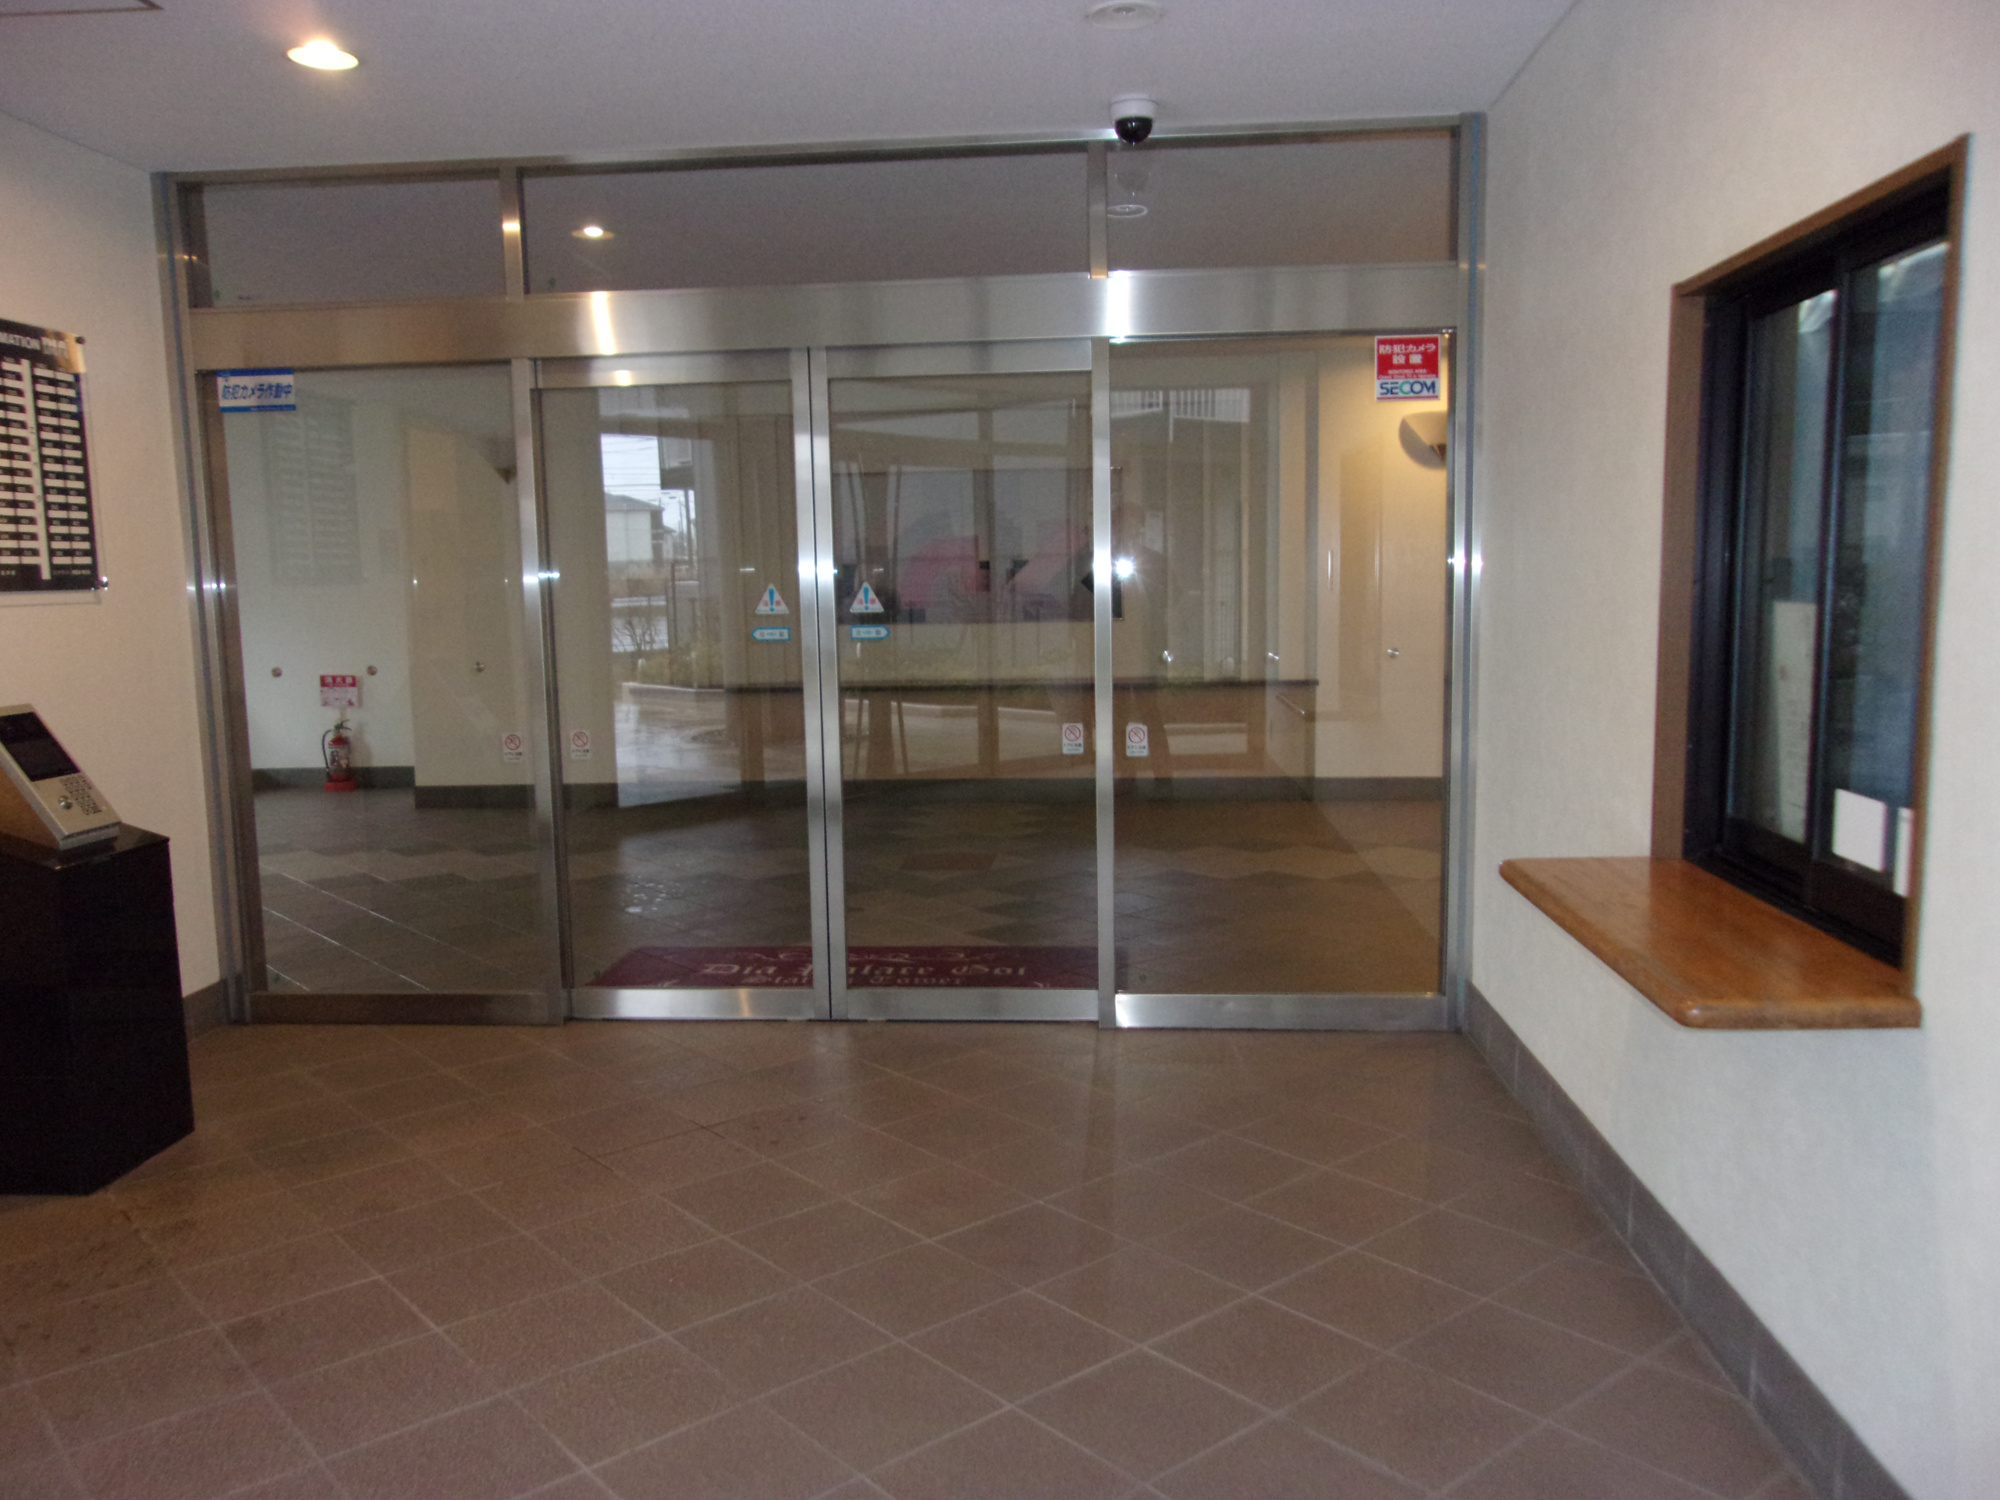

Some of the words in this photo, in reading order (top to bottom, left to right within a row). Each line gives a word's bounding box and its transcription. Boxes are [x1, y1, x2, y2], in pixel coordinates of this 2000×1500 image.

[1379, 343, 1436, 354] 防犯カメラ
[1392, 354, 1423, 365] 設置
[222, 383, 293, 399] 防犯カメラ作動中
[1380, 380, 1436, 395] SECOM
[703, 963, 778, 975] Dia
